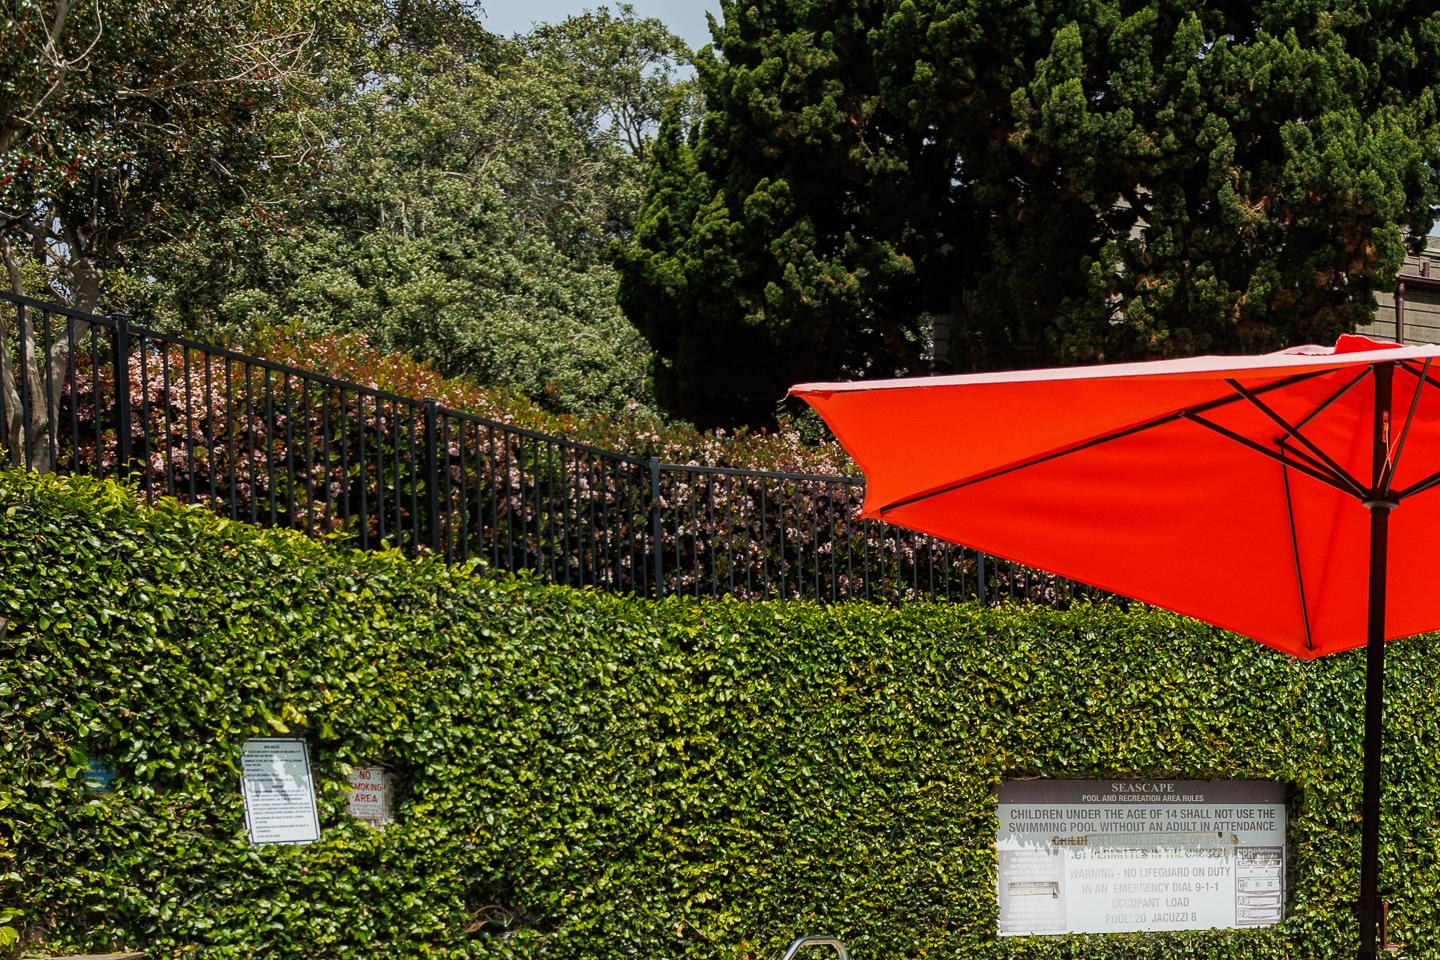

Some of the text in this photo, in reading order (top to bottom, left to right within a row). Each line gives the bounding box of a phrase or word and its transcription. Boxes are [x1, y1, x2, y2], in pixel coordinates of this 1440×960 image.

[359, 770, 371, 780] NO
[1111, 782, 1175, 793] SEASCAPE
[354, 793, 378, 803] AREA
[1082, 793, 1205, 803] POOL AND RECREATION AREA RULES
[1010, 808, 1276, 820] CHILDREN UNDER THE AGE OF 14 SHALL NOT USE THE
[1008, 821, 1278, 833] SWIMMING POOL WITHOUT AN ADULT IN ATTENDANCE.
[1070, 868, 1114, 879] WARNING
[1123, 867, 1137, 878] NO
[1139, 867, 1190, 878] LIFEGUARD
[1192, 867, 1205, 877] ON
[1207, 866, 1231, 877] DUTY
[1082, 881, 1219, 894] IN AN EMERGENCY DIAL 9-1-1
[1112, 897, 1190, 908] OCCUPANT LOAD
[1105, 911, 1197, 924] POOL: 20 JACUZZI 8
